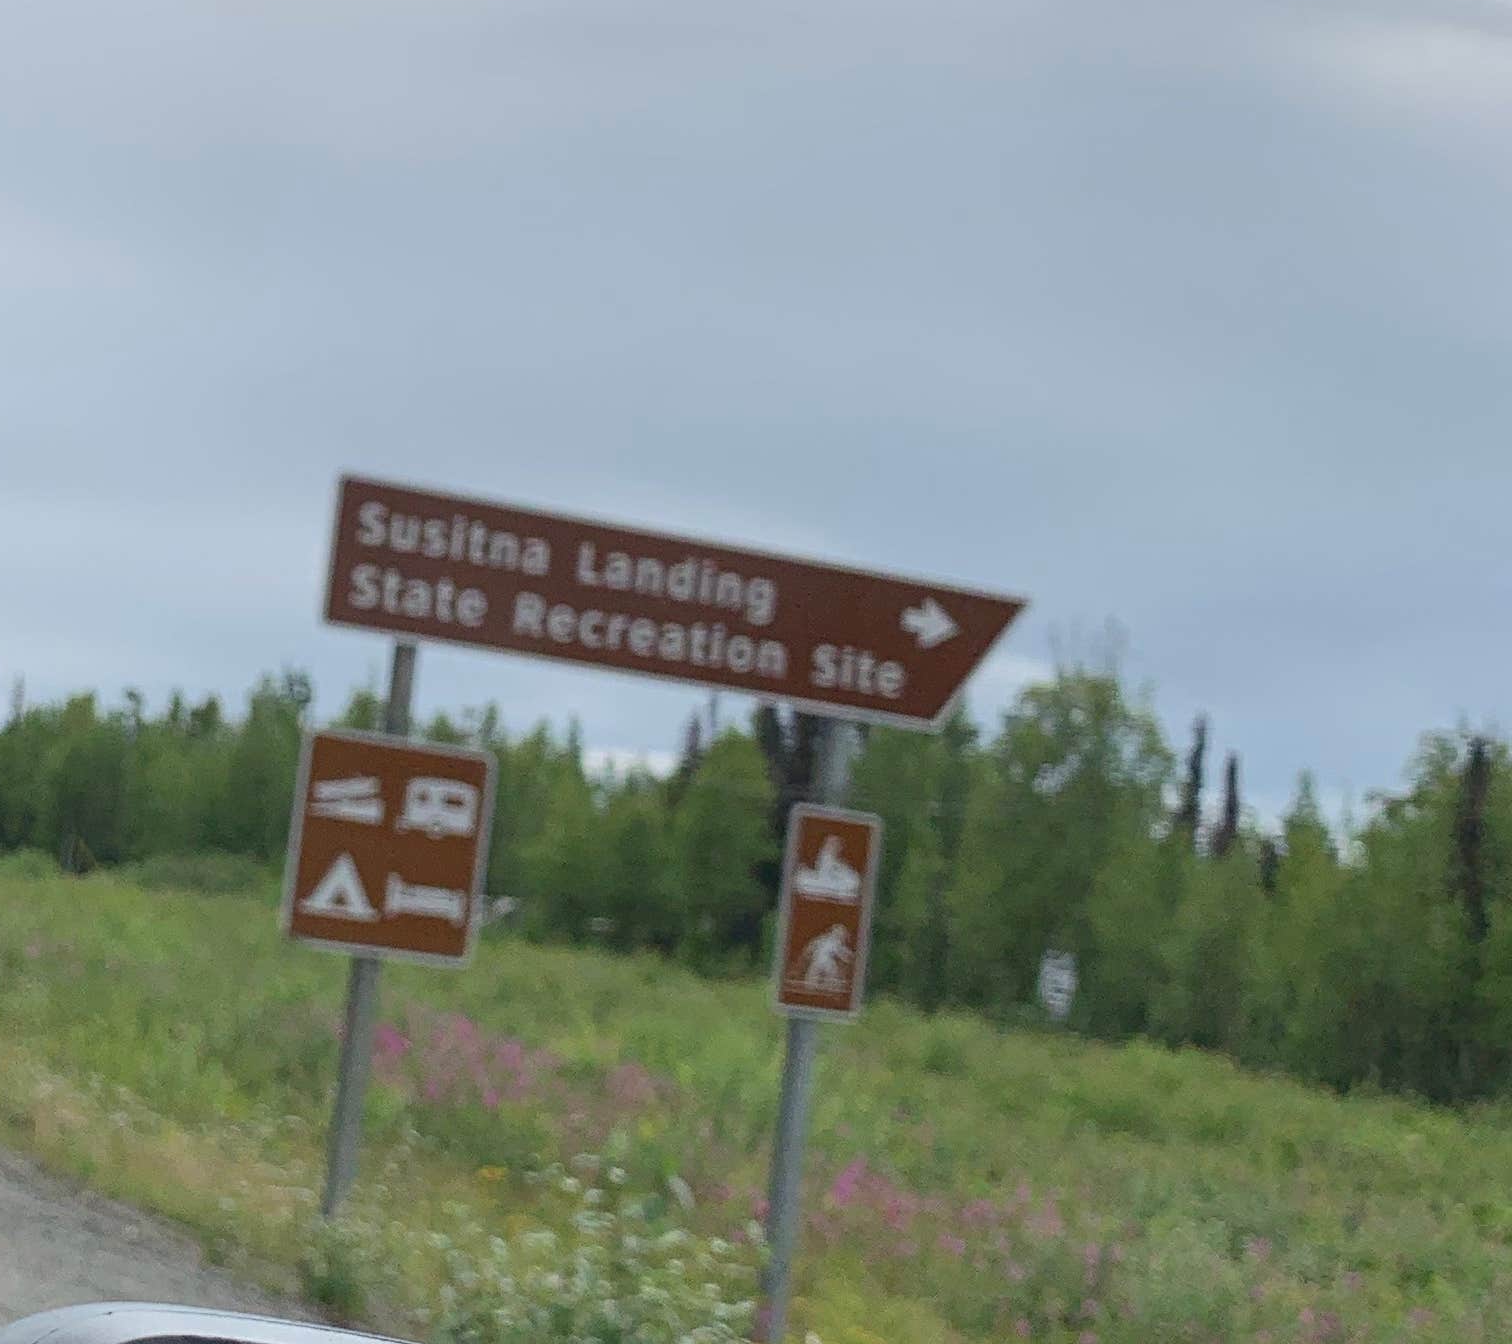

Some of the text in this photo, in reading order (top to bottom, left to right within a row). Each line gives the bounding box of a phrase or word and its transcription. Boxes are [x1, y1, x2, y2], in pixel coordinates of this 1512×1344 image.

[356, 501, 776, 626] Susitna Landing
[350, 562, 906, 698] State Recreation Site
